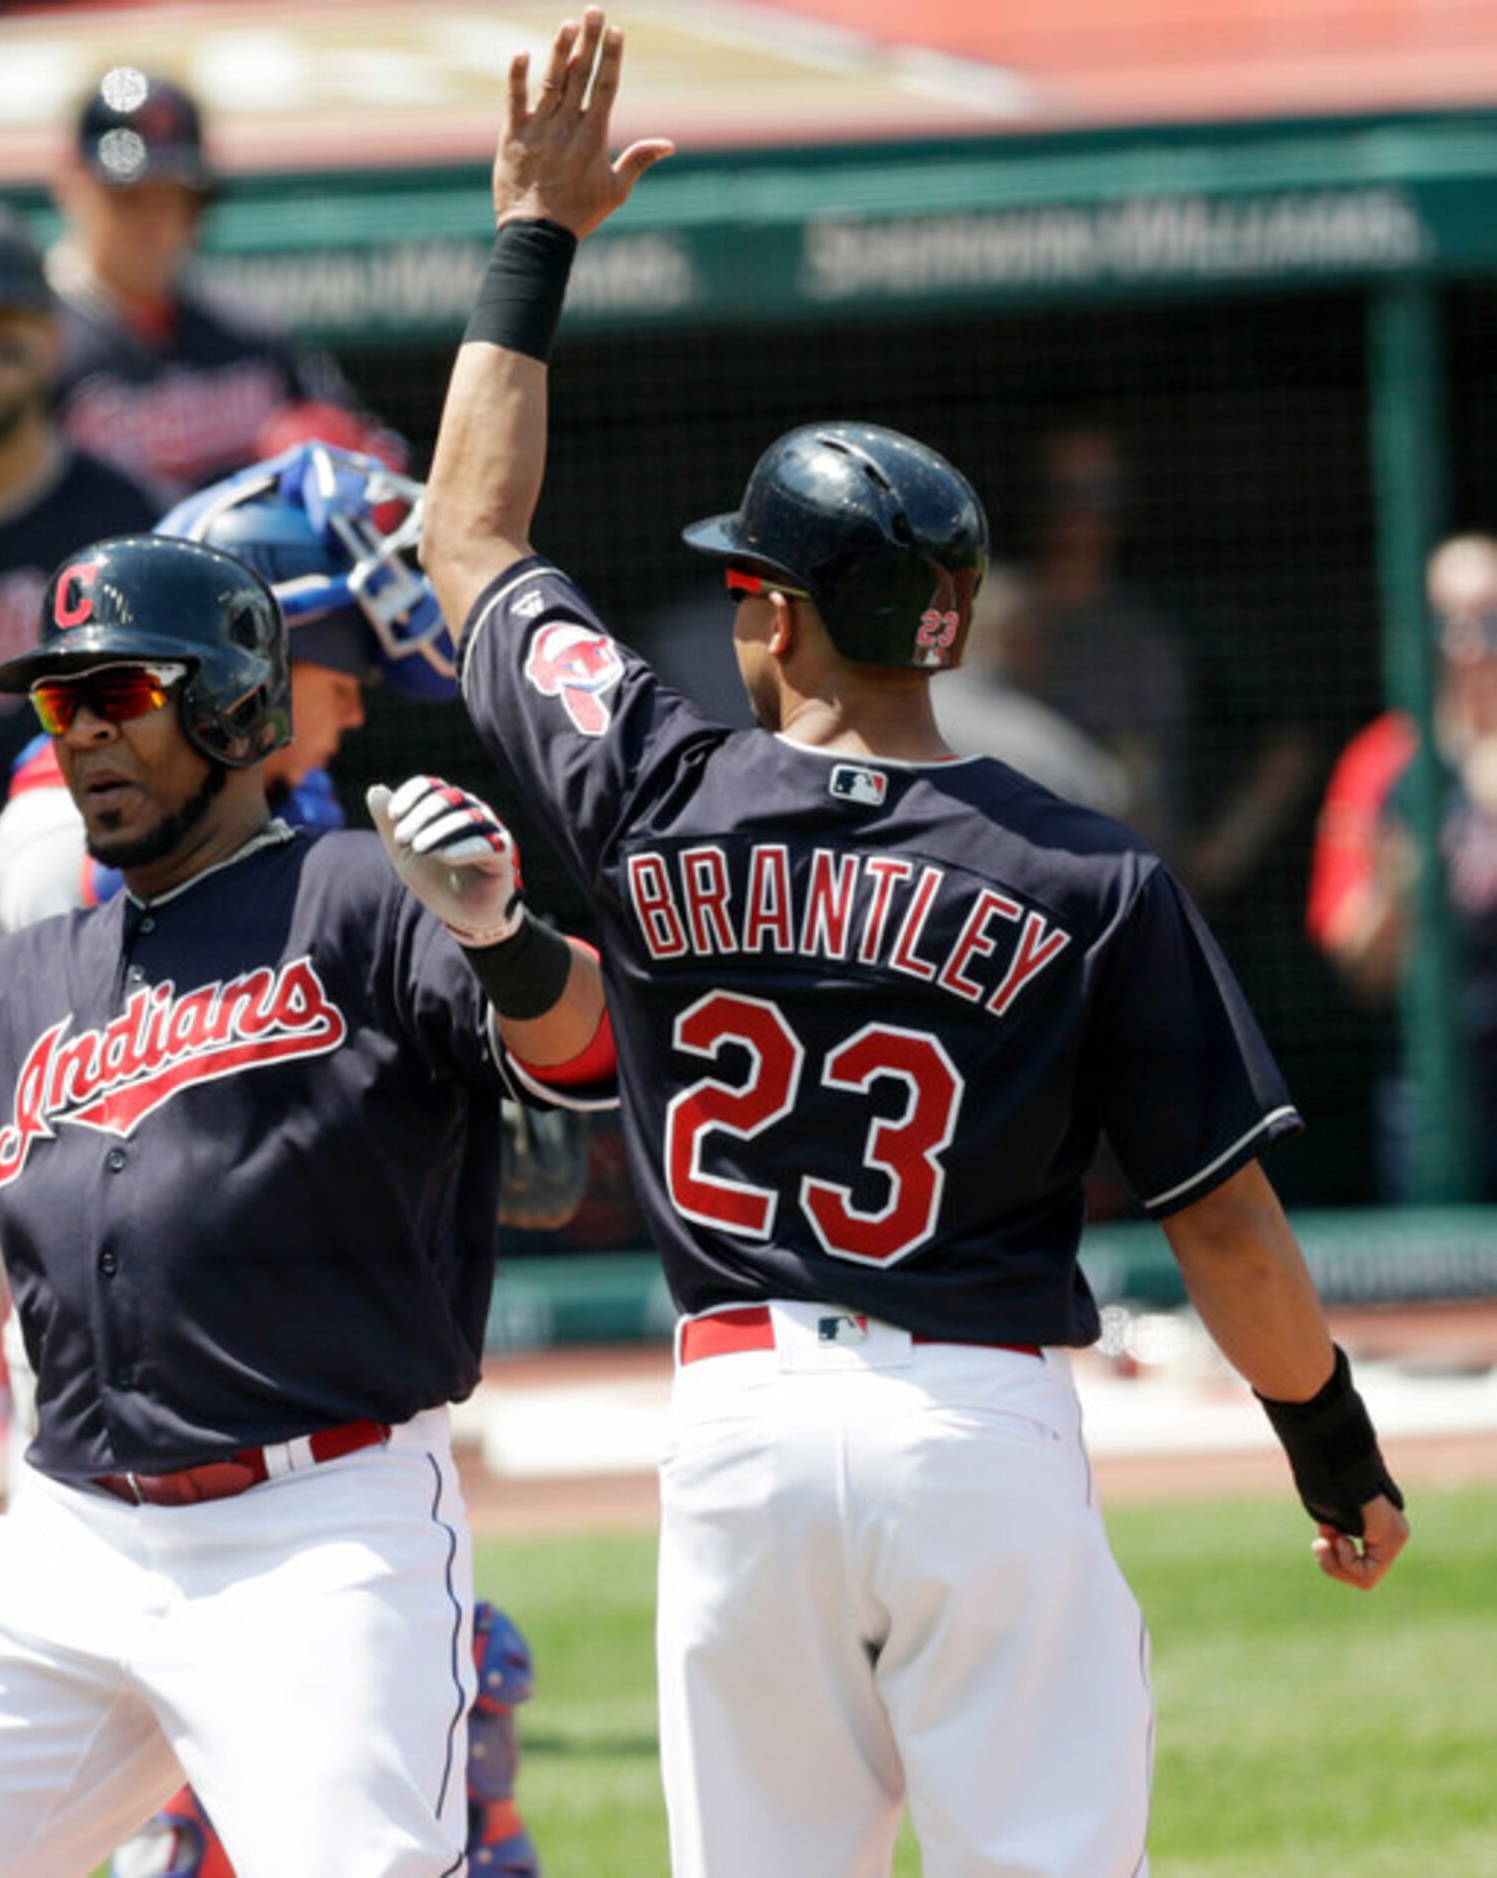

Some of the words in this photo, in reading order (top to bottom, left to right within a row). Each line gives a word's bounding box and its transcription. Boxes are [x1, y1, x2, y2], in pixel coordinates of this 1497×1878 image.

[53, 563, 97, 630] C
[916, 608, 959, 648] 23
[627, 843, 1072, 1017] BRANTLEY
[664, 988, 965, 1268] 23
